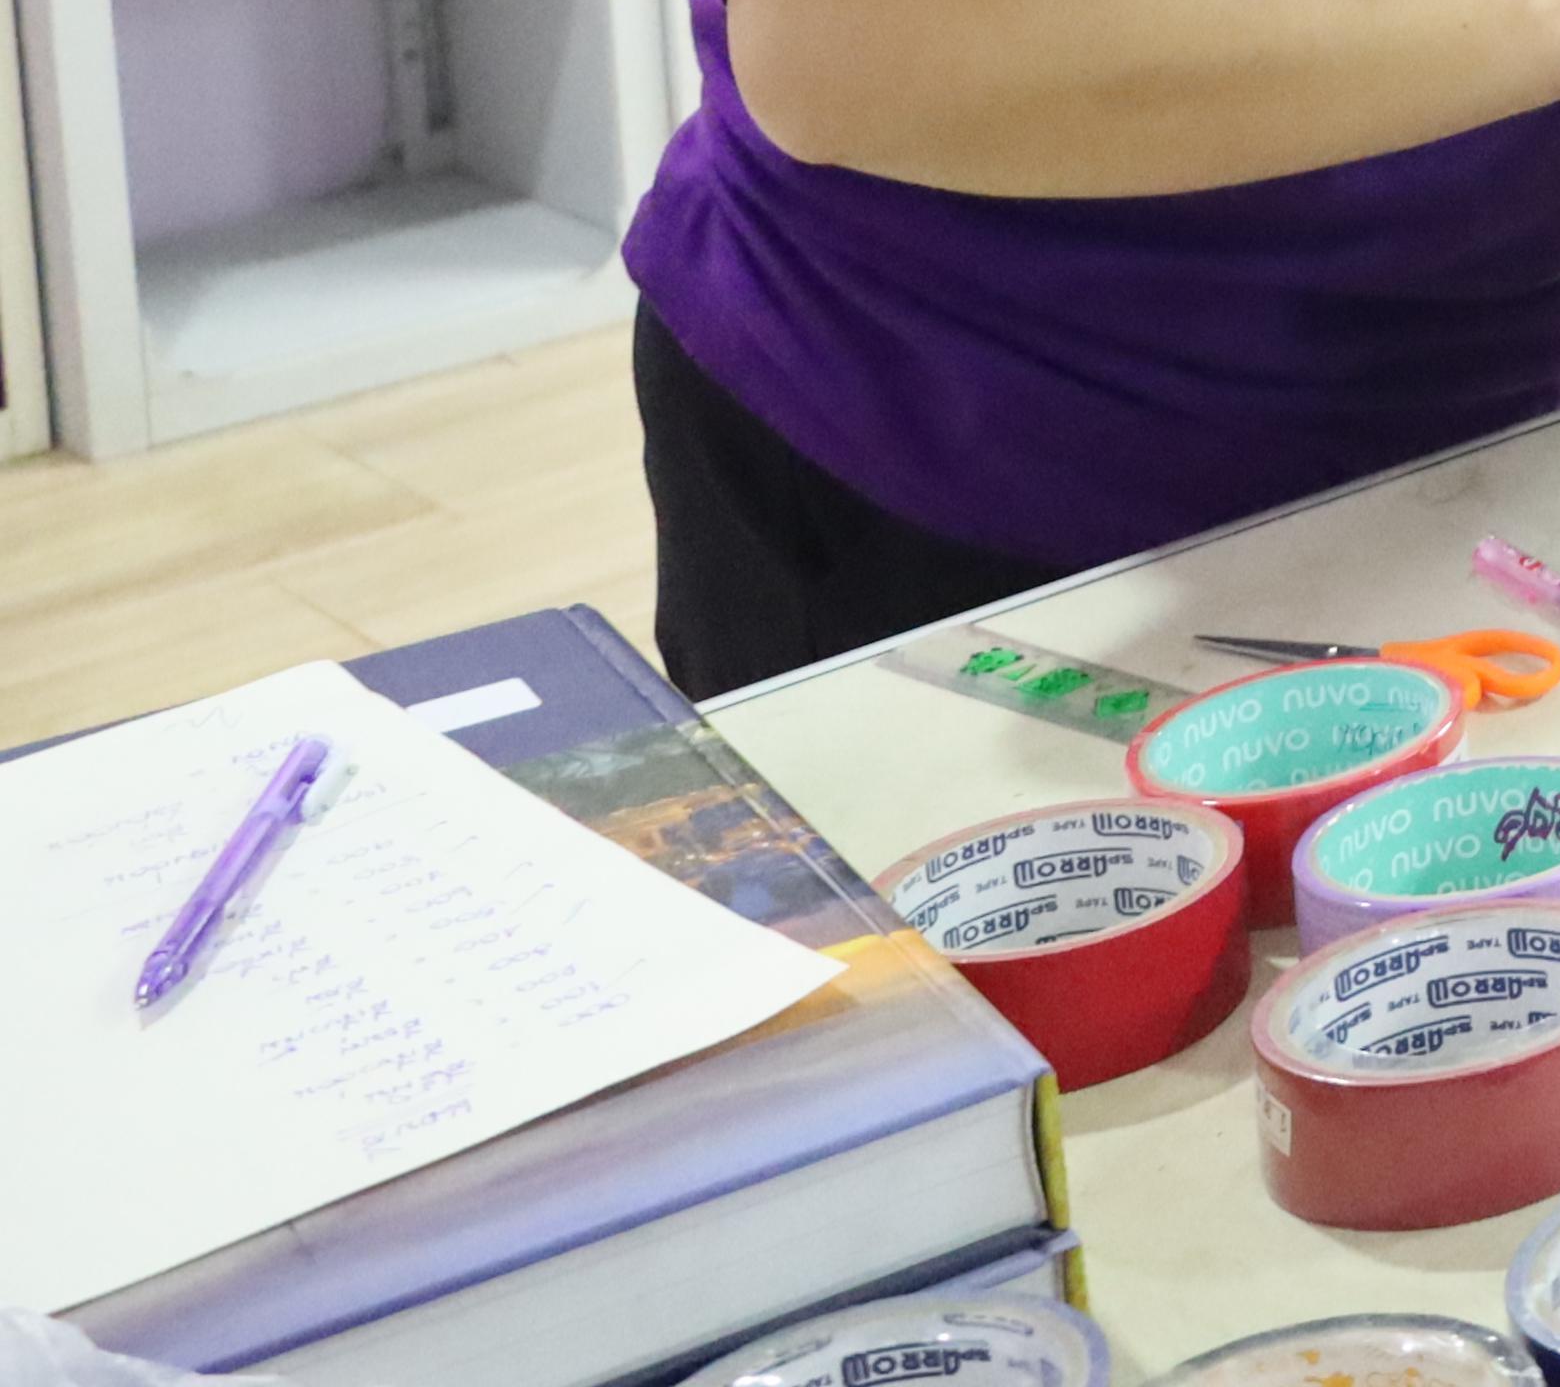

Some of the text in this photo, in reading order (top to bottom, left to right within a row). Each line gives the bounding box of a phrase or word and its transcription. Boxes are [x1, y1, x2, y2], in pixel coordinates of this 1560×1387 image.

[1183, 699, 1262, 748] nuvo
[1283, 683, 1371, 713] nuvo
[1222, 729, 1311, 771] nuvo
[1339, 809, 1412, 861] nuvo
[1433, 788, 1527, 822] nuvo
[926, 824, 1035, 883] SPARROW
[1014, 848, 1134, 889] SPARROW
[1391, 834, 1481, 877] nuvo
[943, 894, 1058, 949] SPARROW
[1467, 938, 1502, 950] TAPE
[1335, 936, 1450, 1002] SPARROW
[1427, 970, 1549, 1009] SPARROW
[1388, 995, 1420, 1011] TAPE
